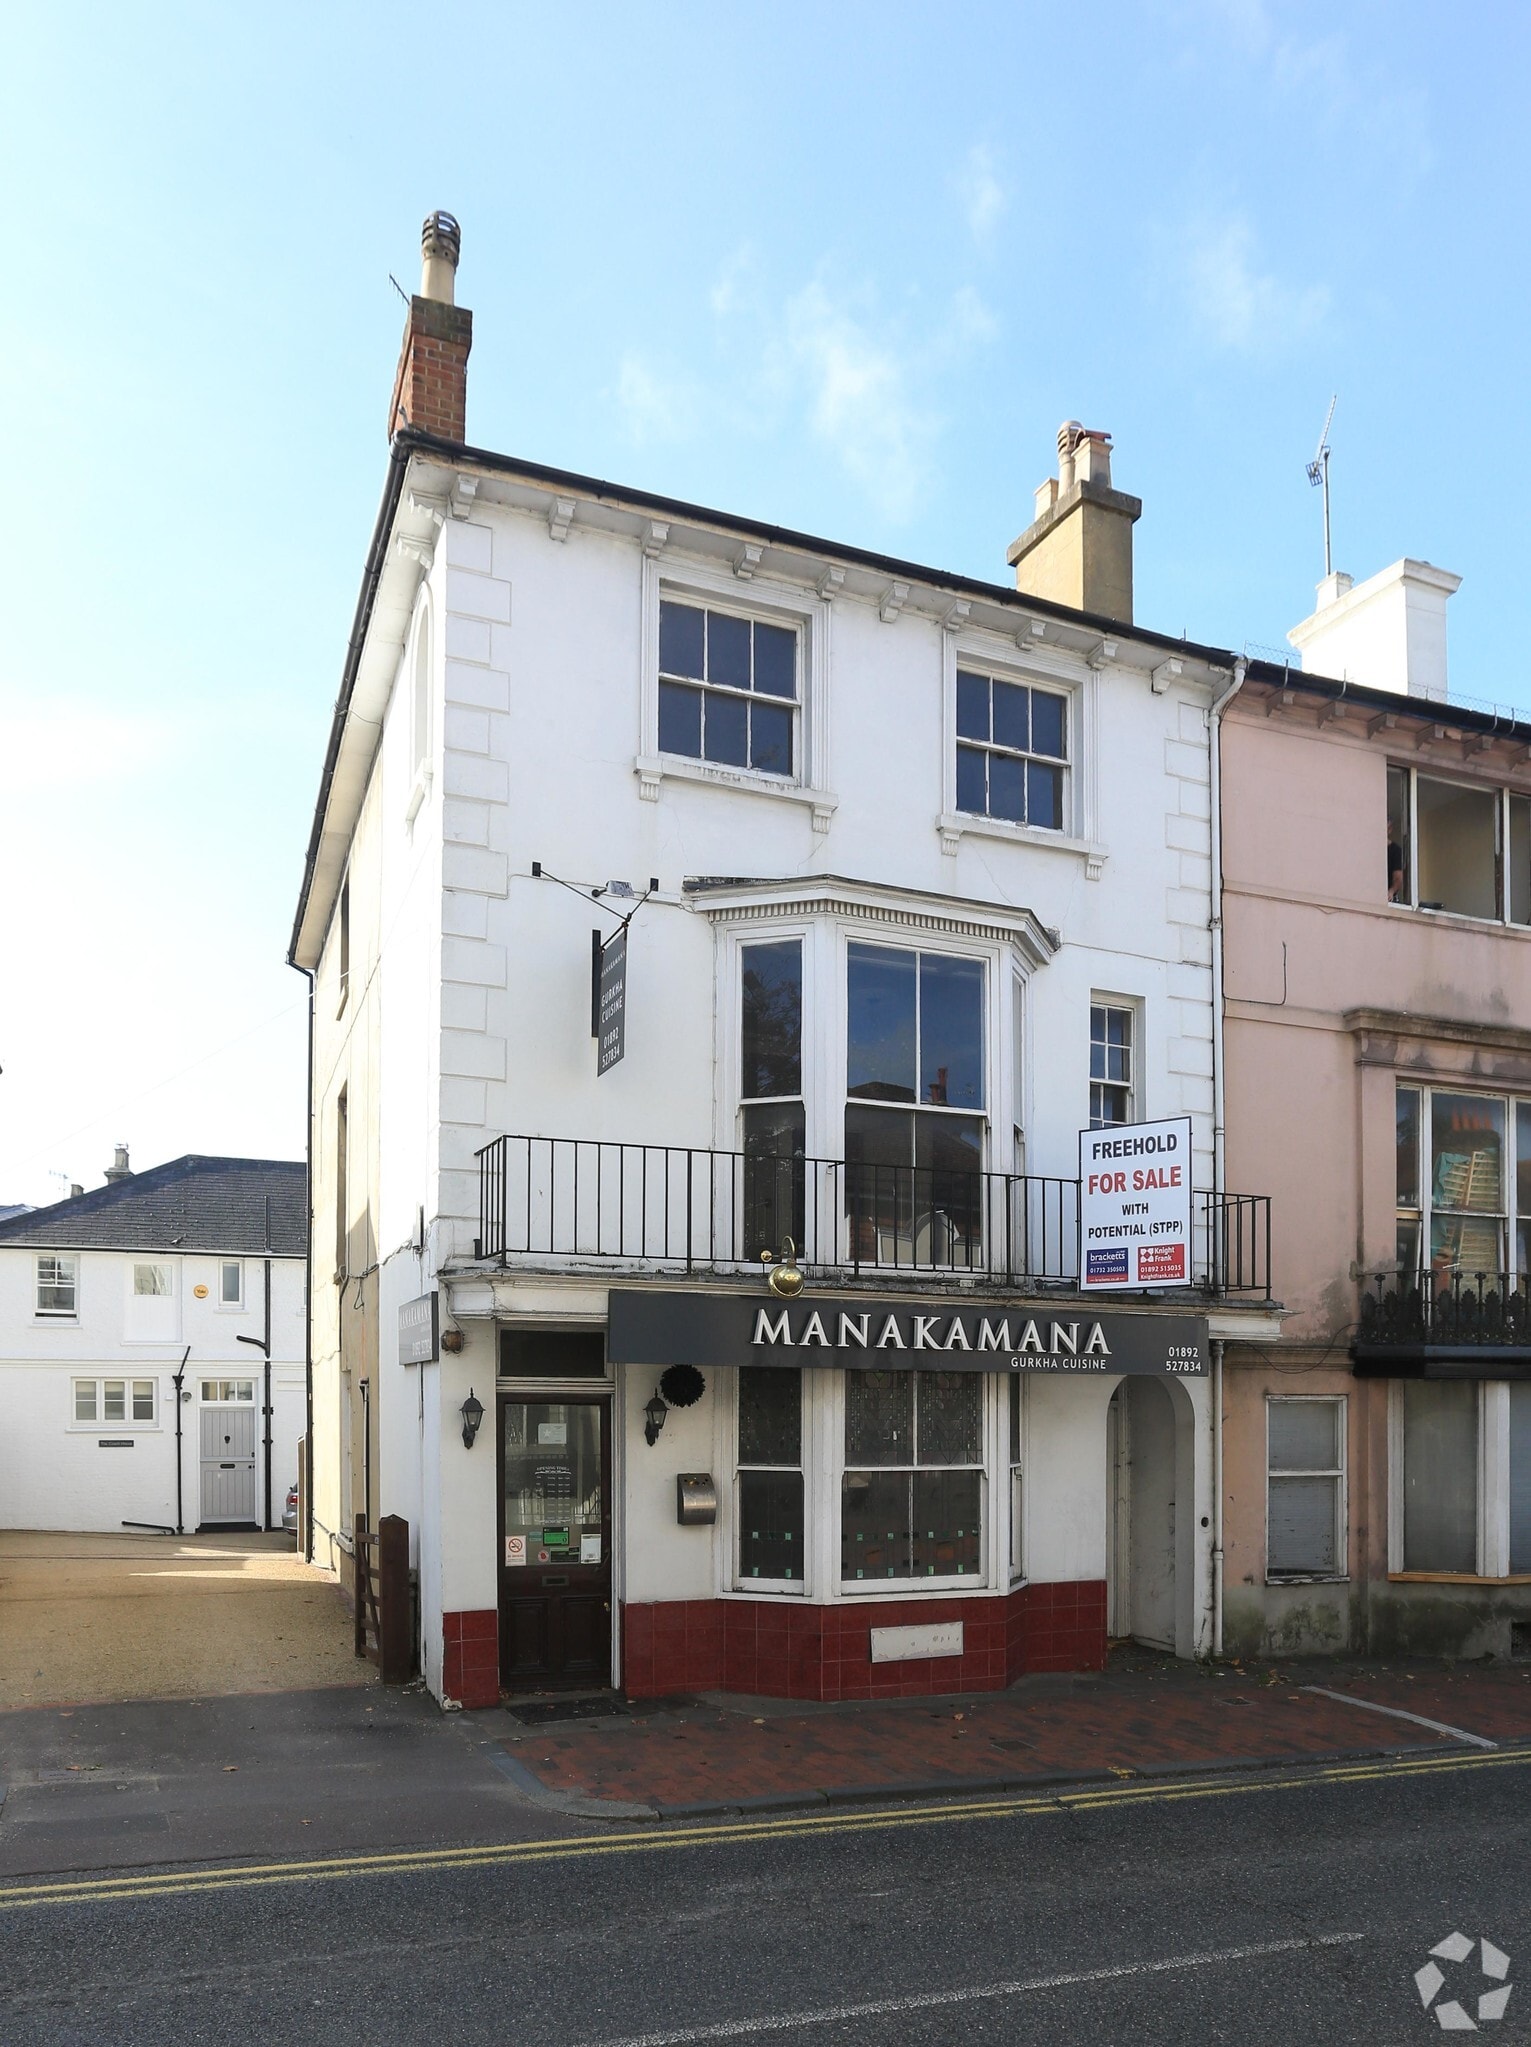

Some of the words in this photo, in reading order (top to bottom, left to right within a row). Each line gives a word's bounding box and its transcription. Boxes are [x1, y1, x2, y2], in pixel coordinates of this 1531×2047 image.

[601, 978, 623, 1007] GURKHA
[602, 995, 623, 1024] CUISINE
[603, 1026, 619, 1049] 01892
[602, 1043, 620, 1069] 527834
[1092, 1133, 1178, 1160] FREEHOLD
[1088, 1172, 1127, 1195] FOR
[1132, 1166, 1182, 1191] SALE
[1121, 1202, 1149, 1216] WITH
[1088, 1224, 1146, 1239] POTENTIAL
[1149, 1220, 1183, 1237] (STPP)
[1090, 1251, 1126, 1262] bracketts
[1154, 1246, 1175, 1255] Knight
[1140, 1265, 1159, 1273] 01892
[1160, 1264, 1182, 1272] 515035
[750, 1308, 1113, 1356] MANAKAMANA
[1168, 1346, 1199, 1358] 01892
[1010, 1357, 1058, 1369] GURKHA
[1062, 1358, 1107, 1370] CUISINE
[1165, 1360, 1202, 1372] 527834
